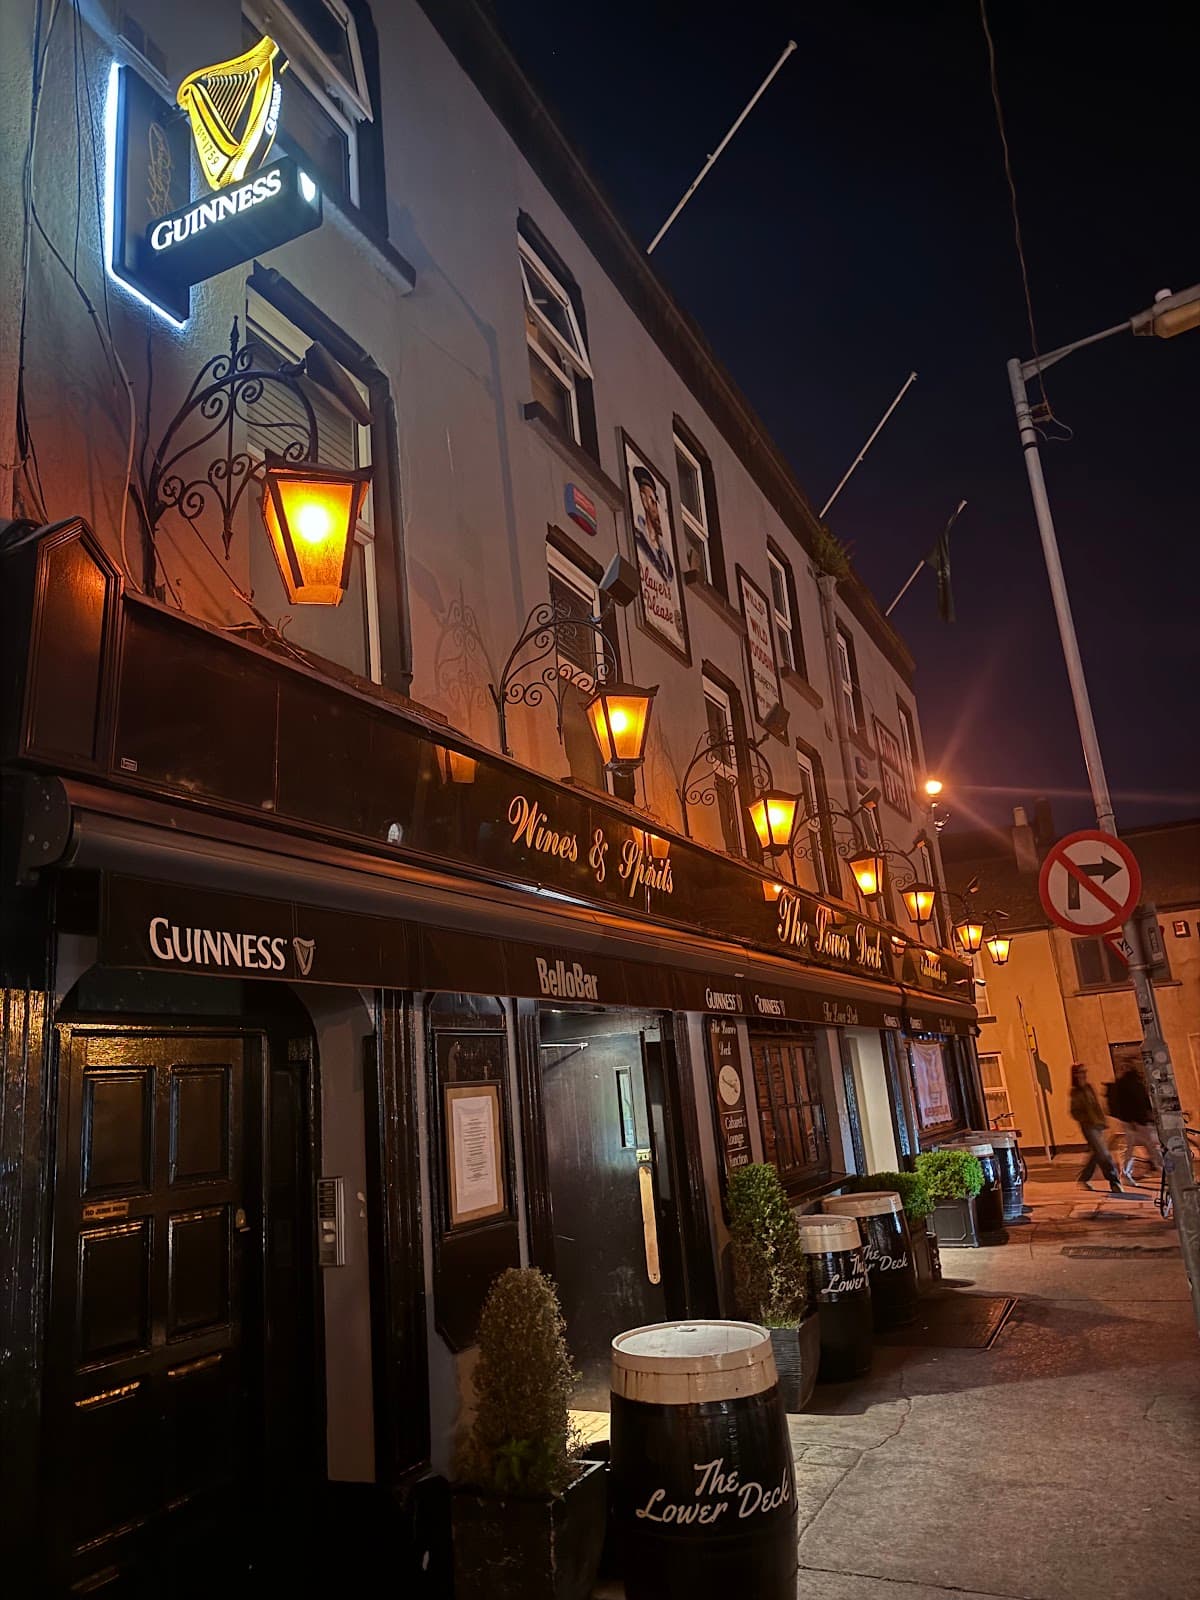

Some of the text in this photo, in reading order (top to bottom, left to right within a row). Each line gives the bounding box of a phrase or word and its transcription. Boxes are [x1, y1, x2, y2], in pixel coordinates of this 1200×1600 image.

[203, 141, 220, 165] 1759
[151, 169, 282, 250] GUINNESS
[508, 796, 673, 898] Wines & Spirits
[149, 917, 287, 971] GUINNESS
[778, 892, 882, 970] The Lower Deck
[536, 957, 598, 1000] BelloBar
[706, 988, 736, 1011] GUINNESS
[863, 1245, 880, 1260] The
[879, 1251, 908, 1271] Deck
[821, 1273, 866, 1294] Lower
[635, 1467, 791, 1525] Lower Deck
[694, 1458, 739, 1497] The
